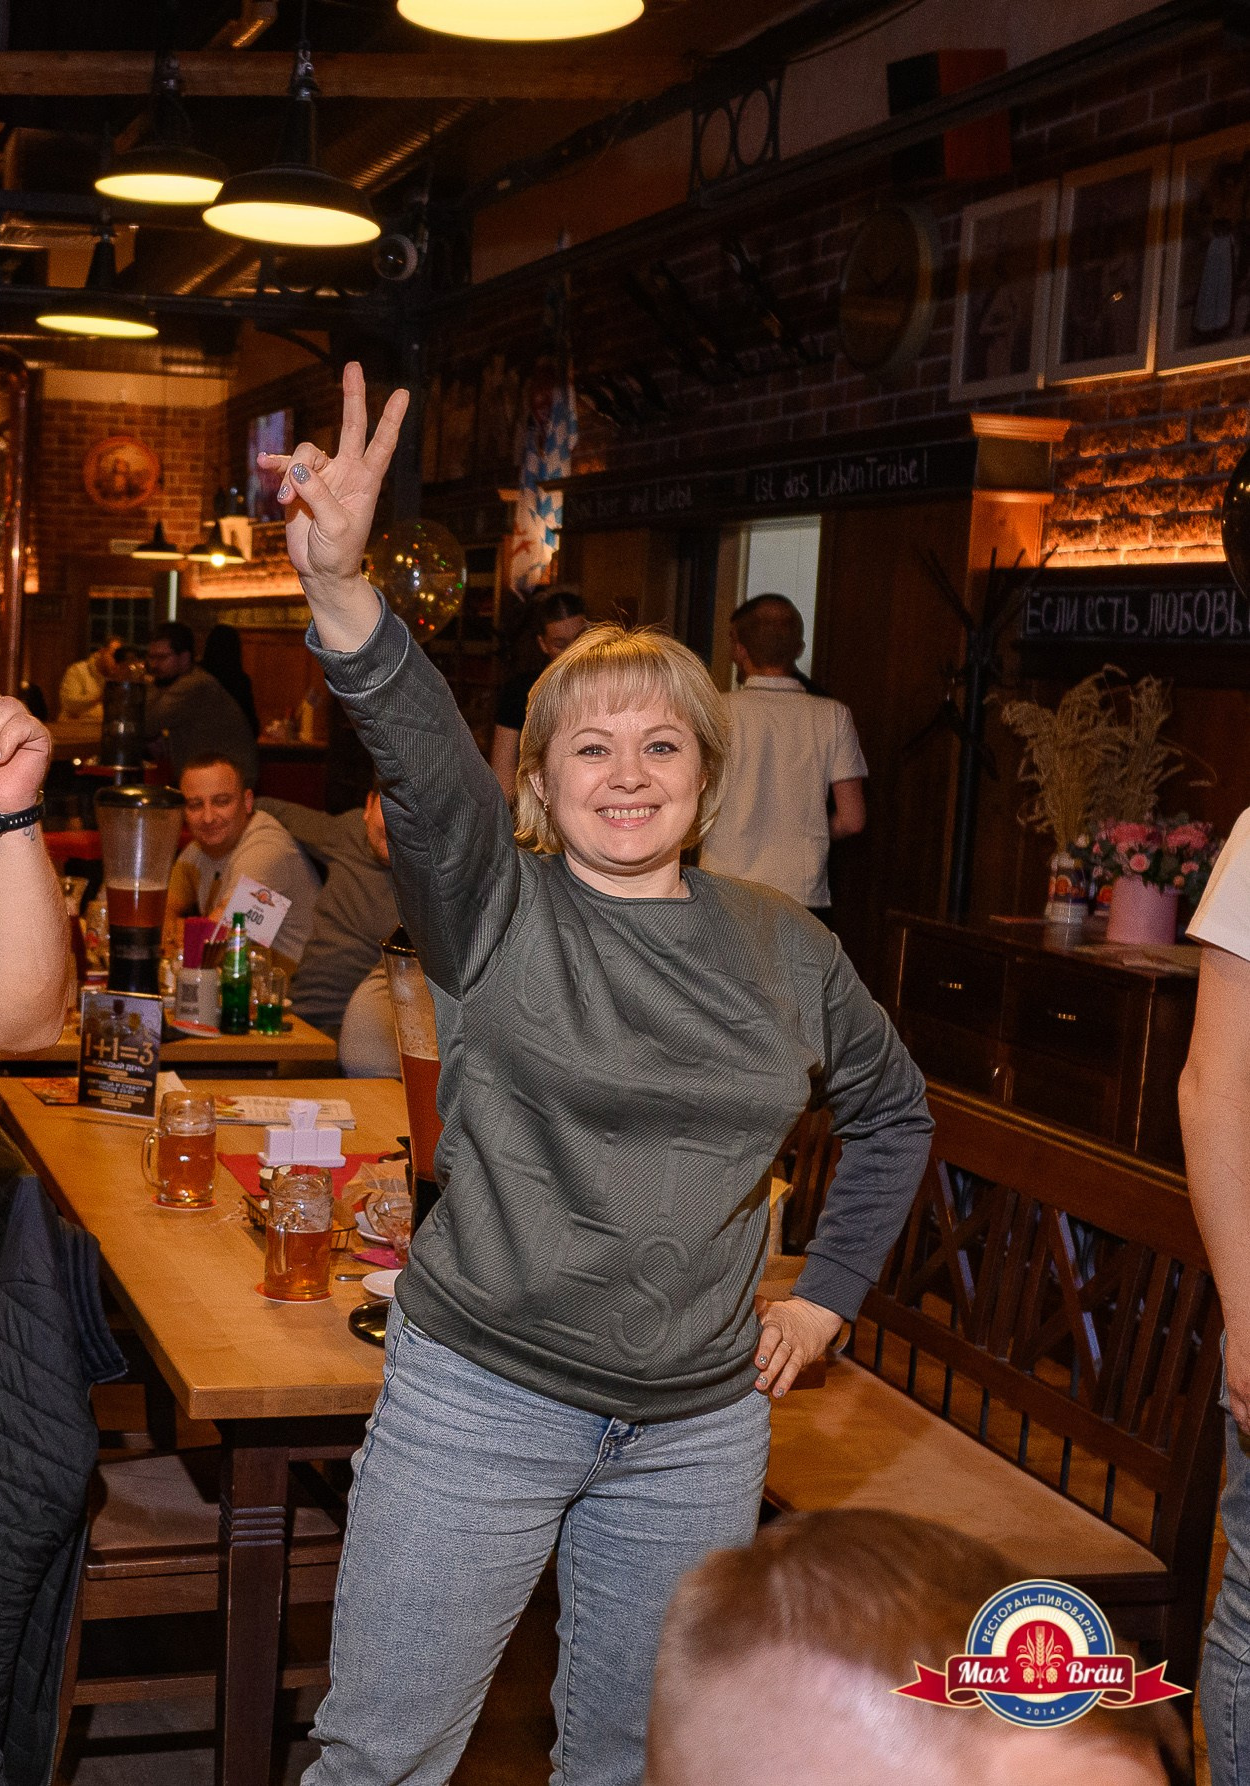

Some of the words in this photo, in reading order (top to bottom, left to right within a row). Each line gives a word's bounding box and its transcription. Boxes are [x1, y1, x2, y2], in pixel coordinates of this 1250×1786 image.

[784, 468, 810, 499] das
[1142, 589, 1243, 637] ЛЮБОВЬ
[245, 909, 265, 925] 400
[85, 1033, 155, 1066] 1+1=3
[125, 1063, 146, 1074] ДЕНЬ
